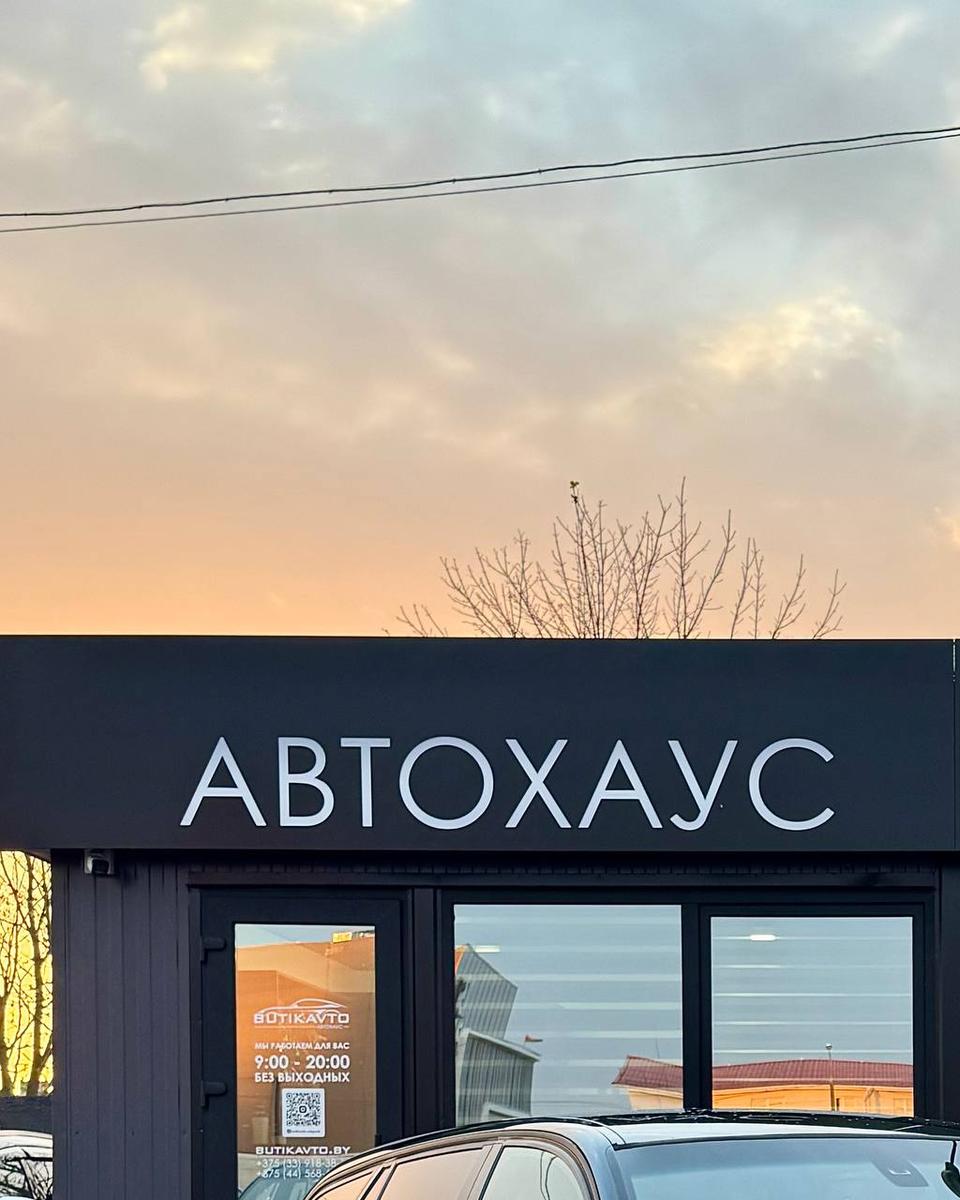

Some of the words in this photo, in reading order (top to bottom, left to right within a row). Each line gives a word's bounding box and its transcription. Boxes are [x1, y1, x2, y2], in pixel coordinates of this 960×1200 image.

[180, 736, 835, 831] АВТОХАУС
[253, 1012, 350, 1024] BUTIKAVTO
[270, 1042, 313, 1050] РАБОТАЕМ
[314, 1042, 331, 1051] ДЛЯ
[333, 1042, 350, 1050] ВАС
[255, 1055, 289, 1070] 9:00
[305, 1055, 350, 1070] 20:00
[254, 1072, 275, 1083] БЕЗ
[277, 1072, 350, 1084] ВЫХОДНЫХ
[255, 1146, 351, 1155] BUTIKAVTO.BY
